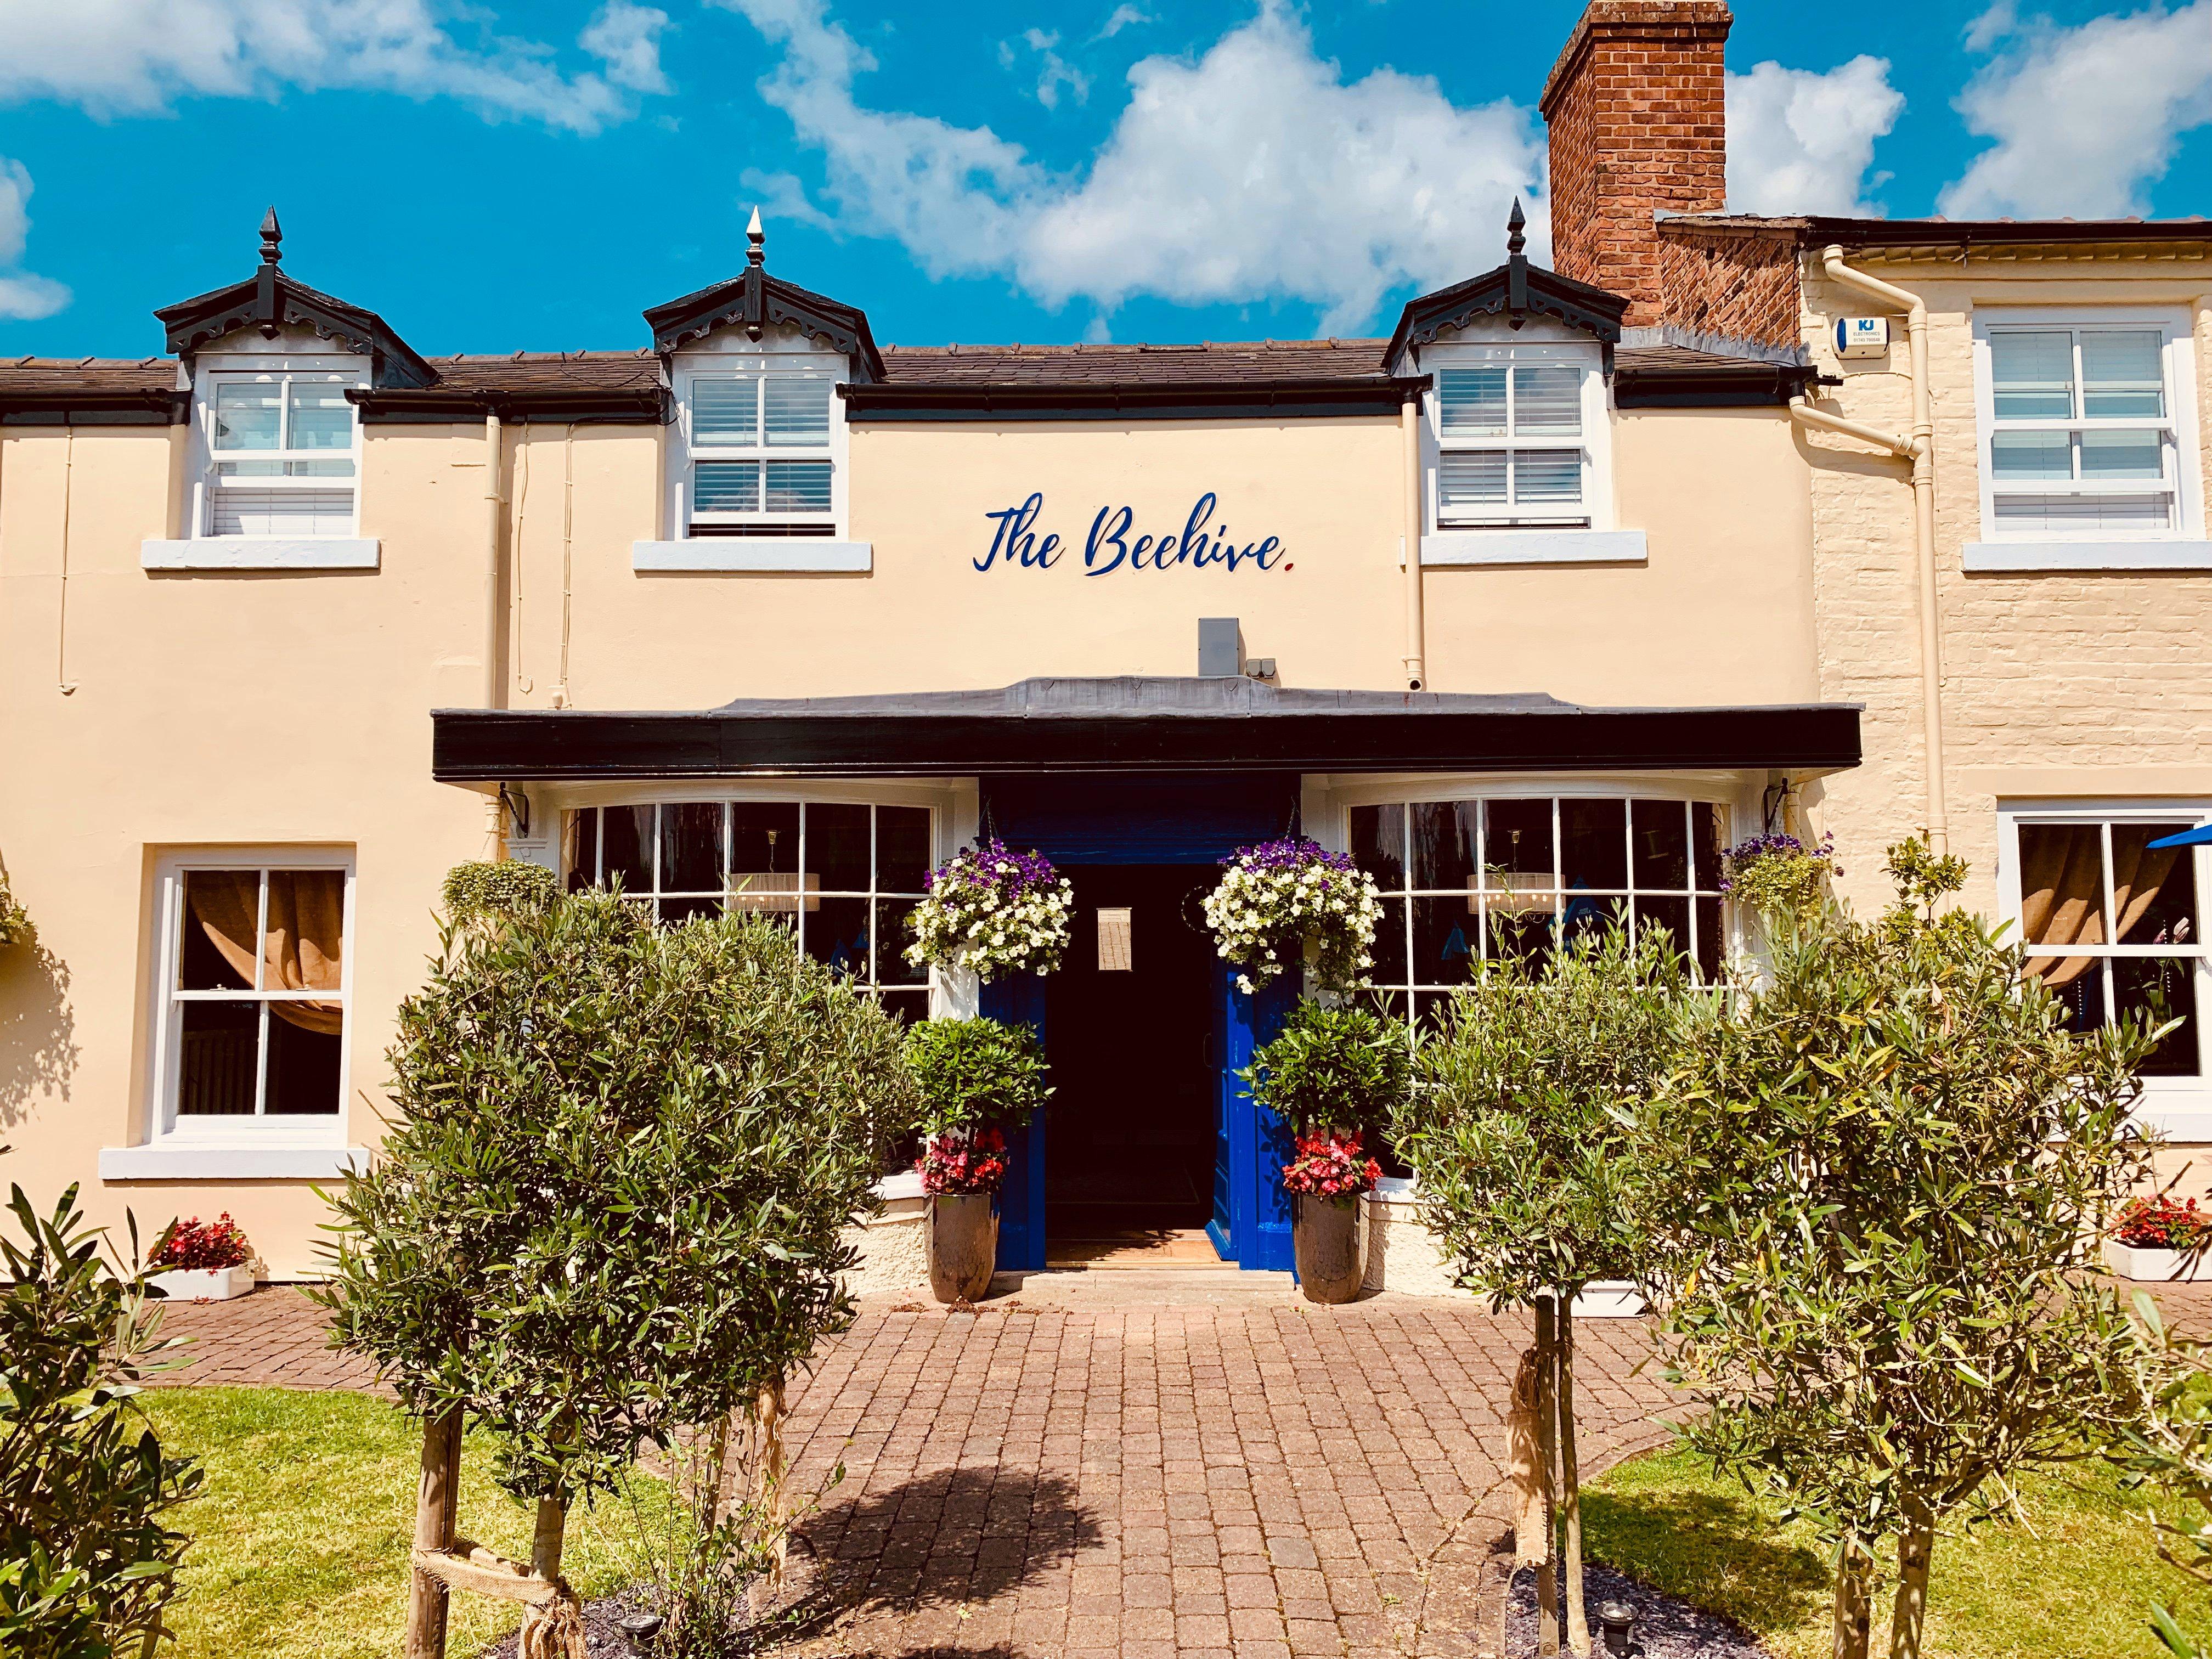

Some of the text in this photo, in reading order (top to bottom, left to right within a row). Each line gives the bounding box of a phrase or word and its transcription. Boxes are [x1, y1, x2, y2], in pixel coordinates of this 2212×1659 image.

[1858, 320, 1874, 331] KJ
[973, 492, 1294, 577] The Beehive.
